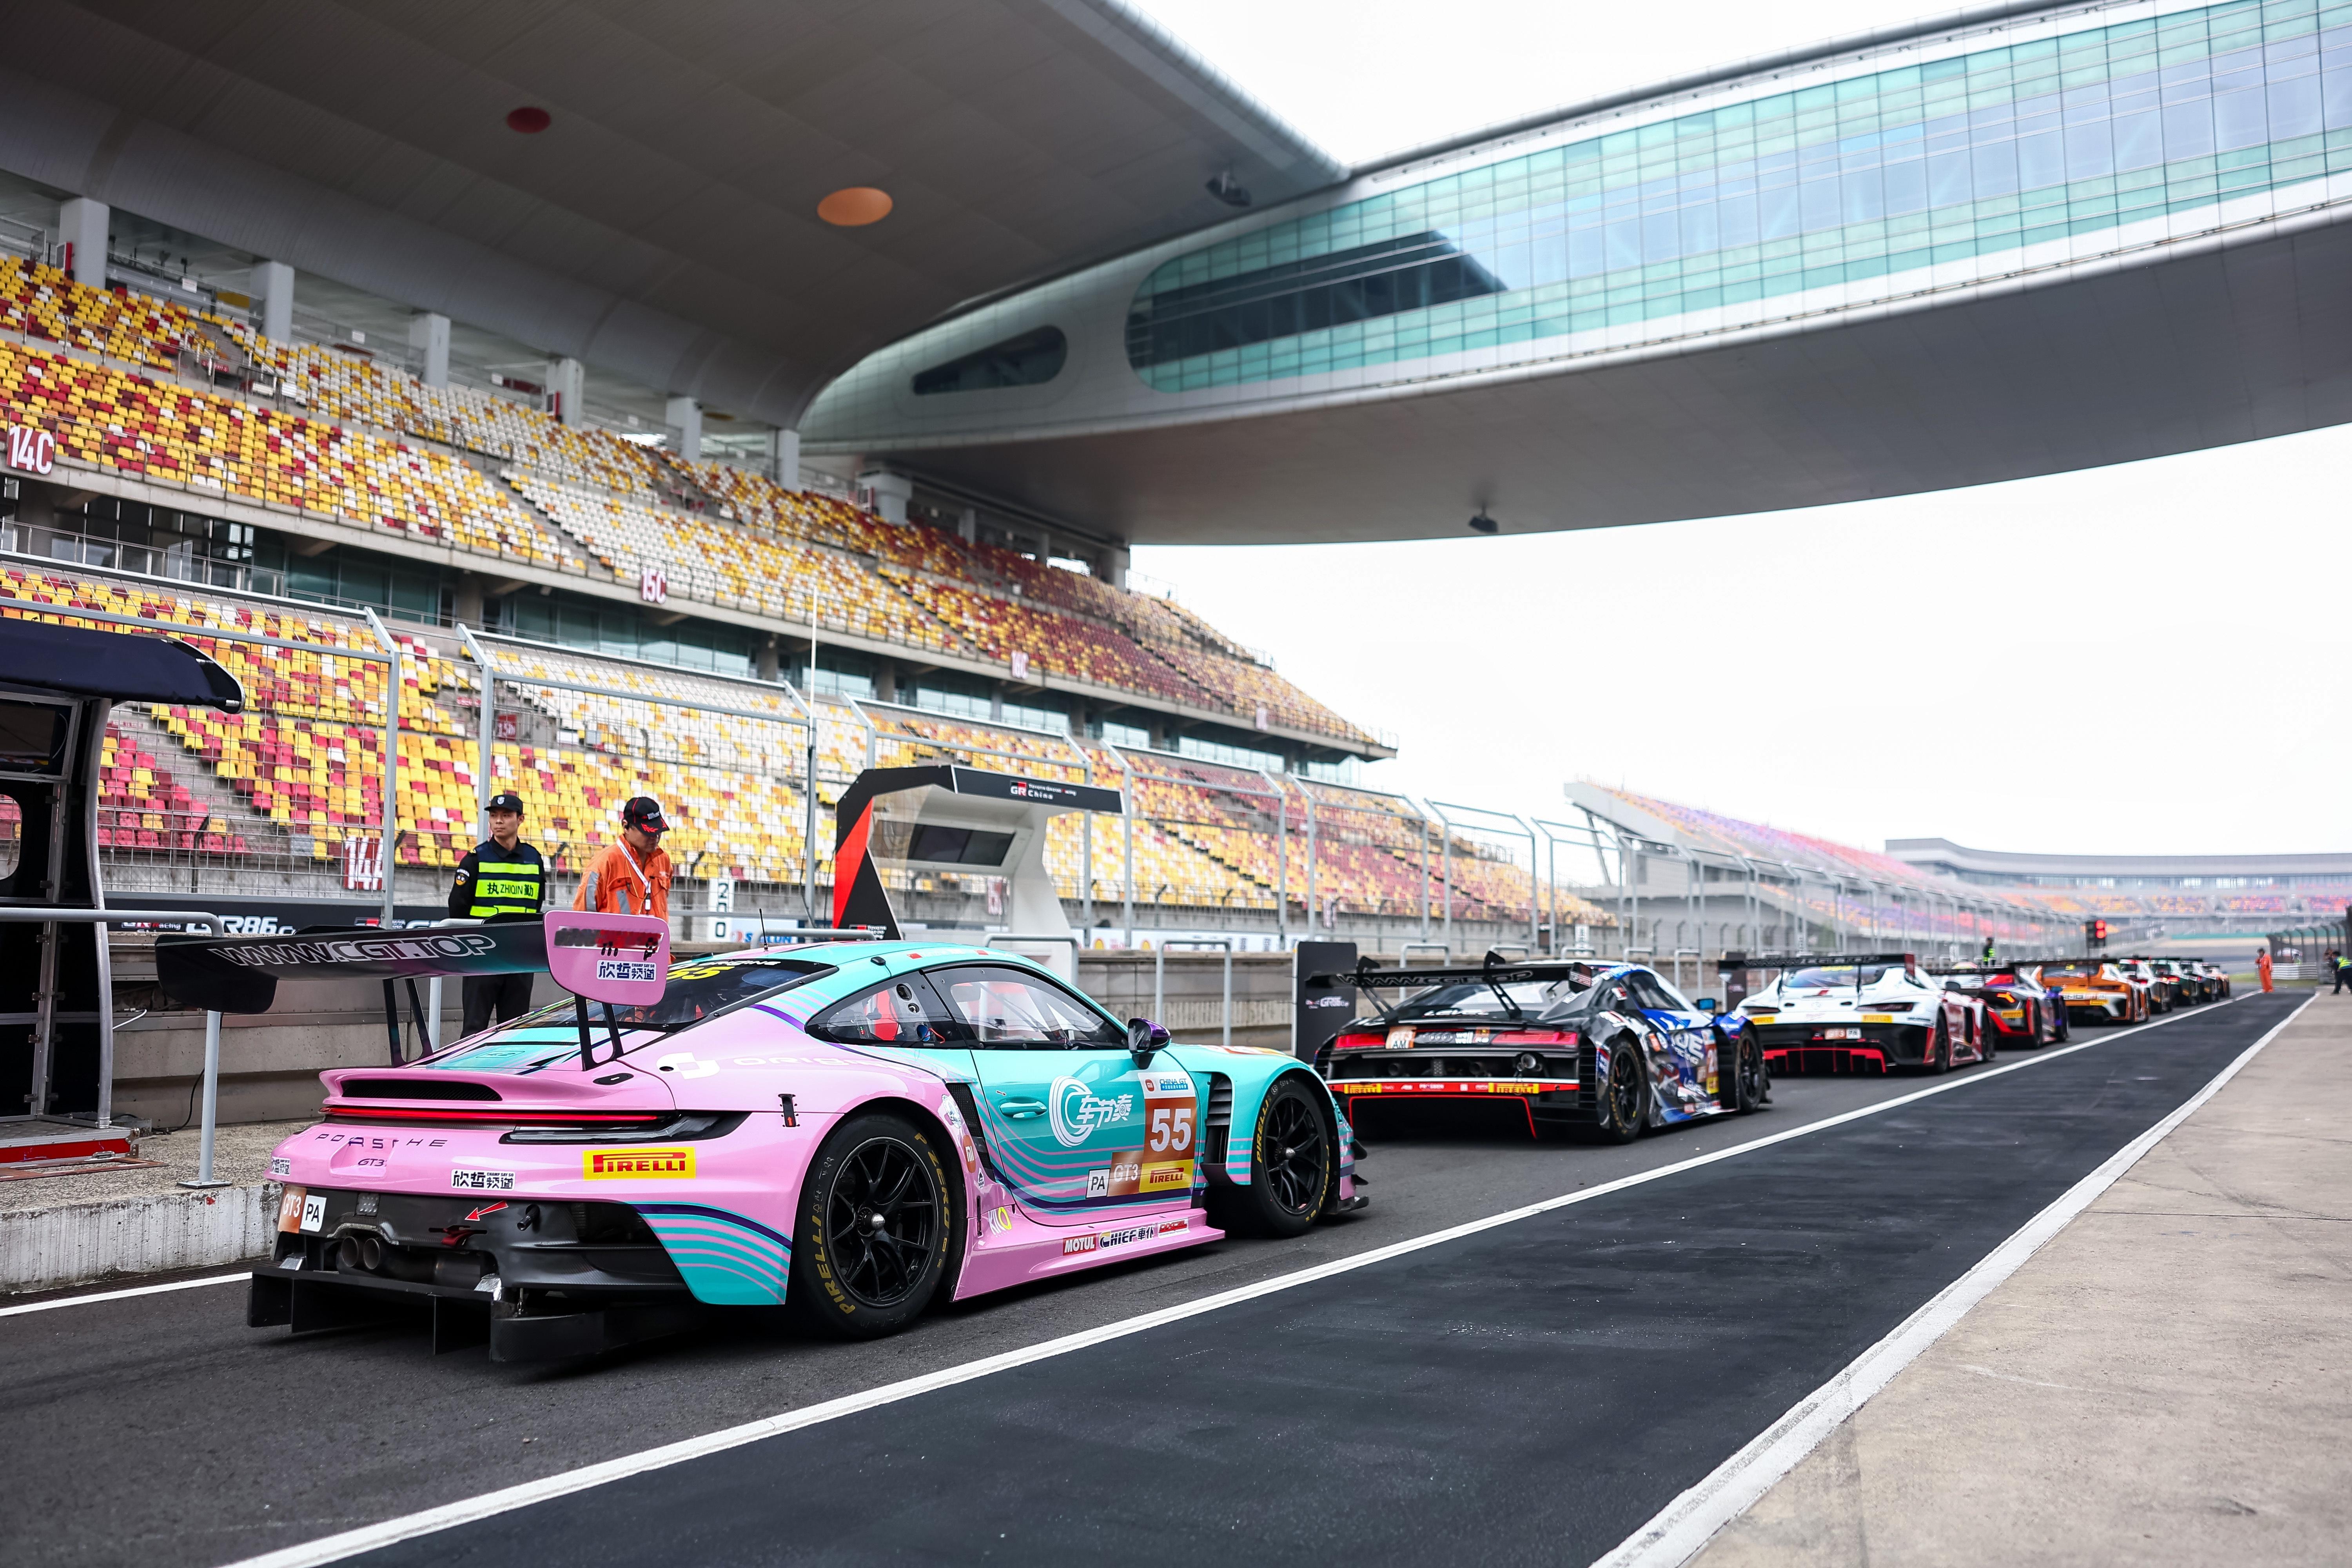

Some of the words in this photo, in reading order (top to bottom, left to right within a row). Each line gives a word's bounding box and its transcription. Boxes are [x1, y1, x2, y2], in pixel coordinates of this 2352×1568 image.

[9, 425, 54, 474] 14C
[642, 567, 666, 604] 15C
[1010, 786, 1027, 796] GR
[1028, 789, 1054, 800] China
[487, 882, 499, 895] 执
[500, 884, 523, 895] ZHIQIN
[524, 884, 534, 897] 勤
[599, 961, 655, 980] 欣哲频道
[1150, 1109, 1192, 1152] 55
[1257, 1099, 1269, 1163] PIRELLI
[593, 1152, 686, 1173] PIRELLI
[453, 1171, 514, 1189] 欣哲频道
[928, 1150, 950, 1229] ZERO
[1091, 1174, 1105, 1191] PA
[1114, 1163, 1139, 1183] GT3
[1150, 1167, 1184, 1184] PIRELLI
[282, 1193, 302, 1218] GT3
[305, 1202, 320, 1223] PA
[1064, 1236, 1095, 1253] MOTUL
[812, 1215, 856, 1314] PIRELLI
